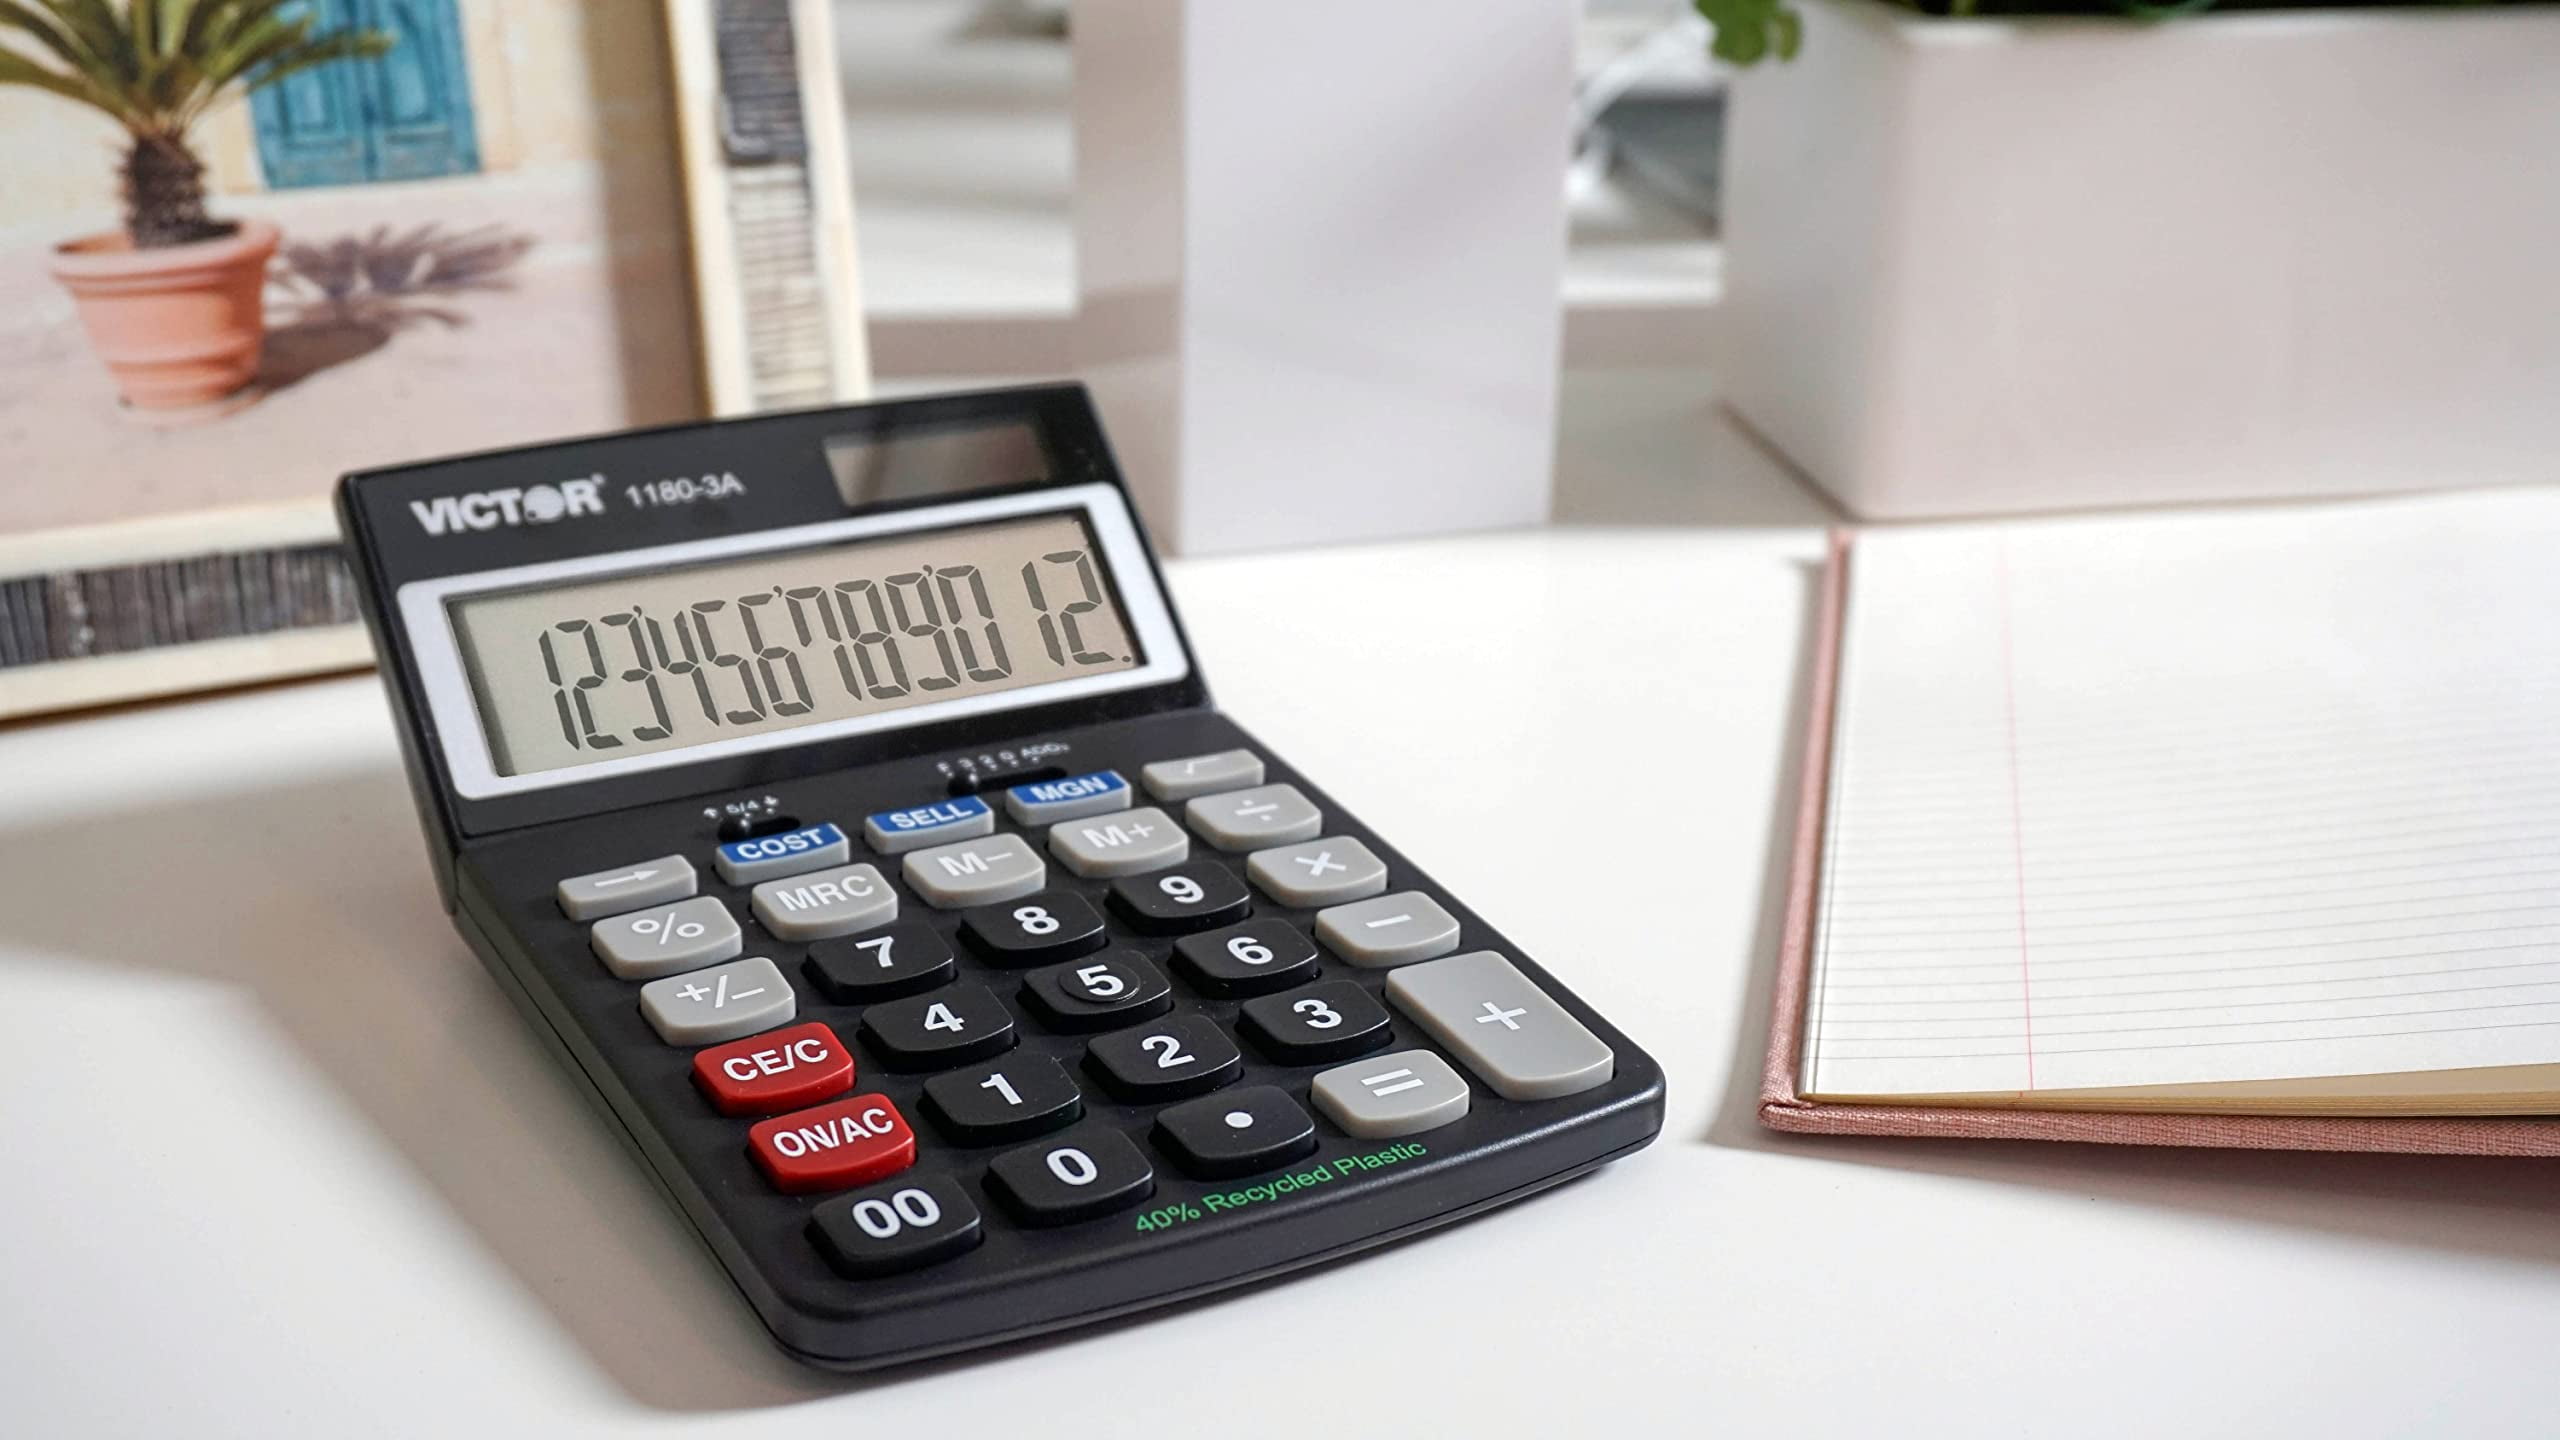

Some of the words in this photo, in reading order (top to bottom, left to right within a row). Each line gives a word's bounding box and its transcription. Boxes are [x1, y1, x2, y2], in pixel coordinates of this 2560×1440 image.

[625, 472, 746, 507] 1180-3A
[1030, 776, 1110, 801] MGN
[889, 803, 974, 831] SELL
[737, 828, 826, 862] COST
[1081, 821, 1155, 849] M+
[775, 874, 875, 912] MRC
[1159, 875, 1205, 904] 9
[631, 911, 705, 946] %
[1012, 906, 1061, 935] 8
[855, 935, 896, 969] 7
[1226, 936, 1274, 965] 6
[1075, 964, 1126, 997] 5
[923, 1001, 966, 1033] 4
[1292, 998, 1343, 1030] 3
[723, 1038, 829, 1082] CE/C
[1141, 1034, 1196, 1070] 2
[979, 1072, 1024, 1106] 1
[772, 1107, 895, 1158] ON/AC
[1045, 1147, 1099, 1186] 0
[1135, 1202, 1201, 1233] 40%
[1202, 1165, 1333, 1213] Recycled
[1332, 1141, 1427, 1176] Plastic
[851, 1187, 942, 1239] 00
